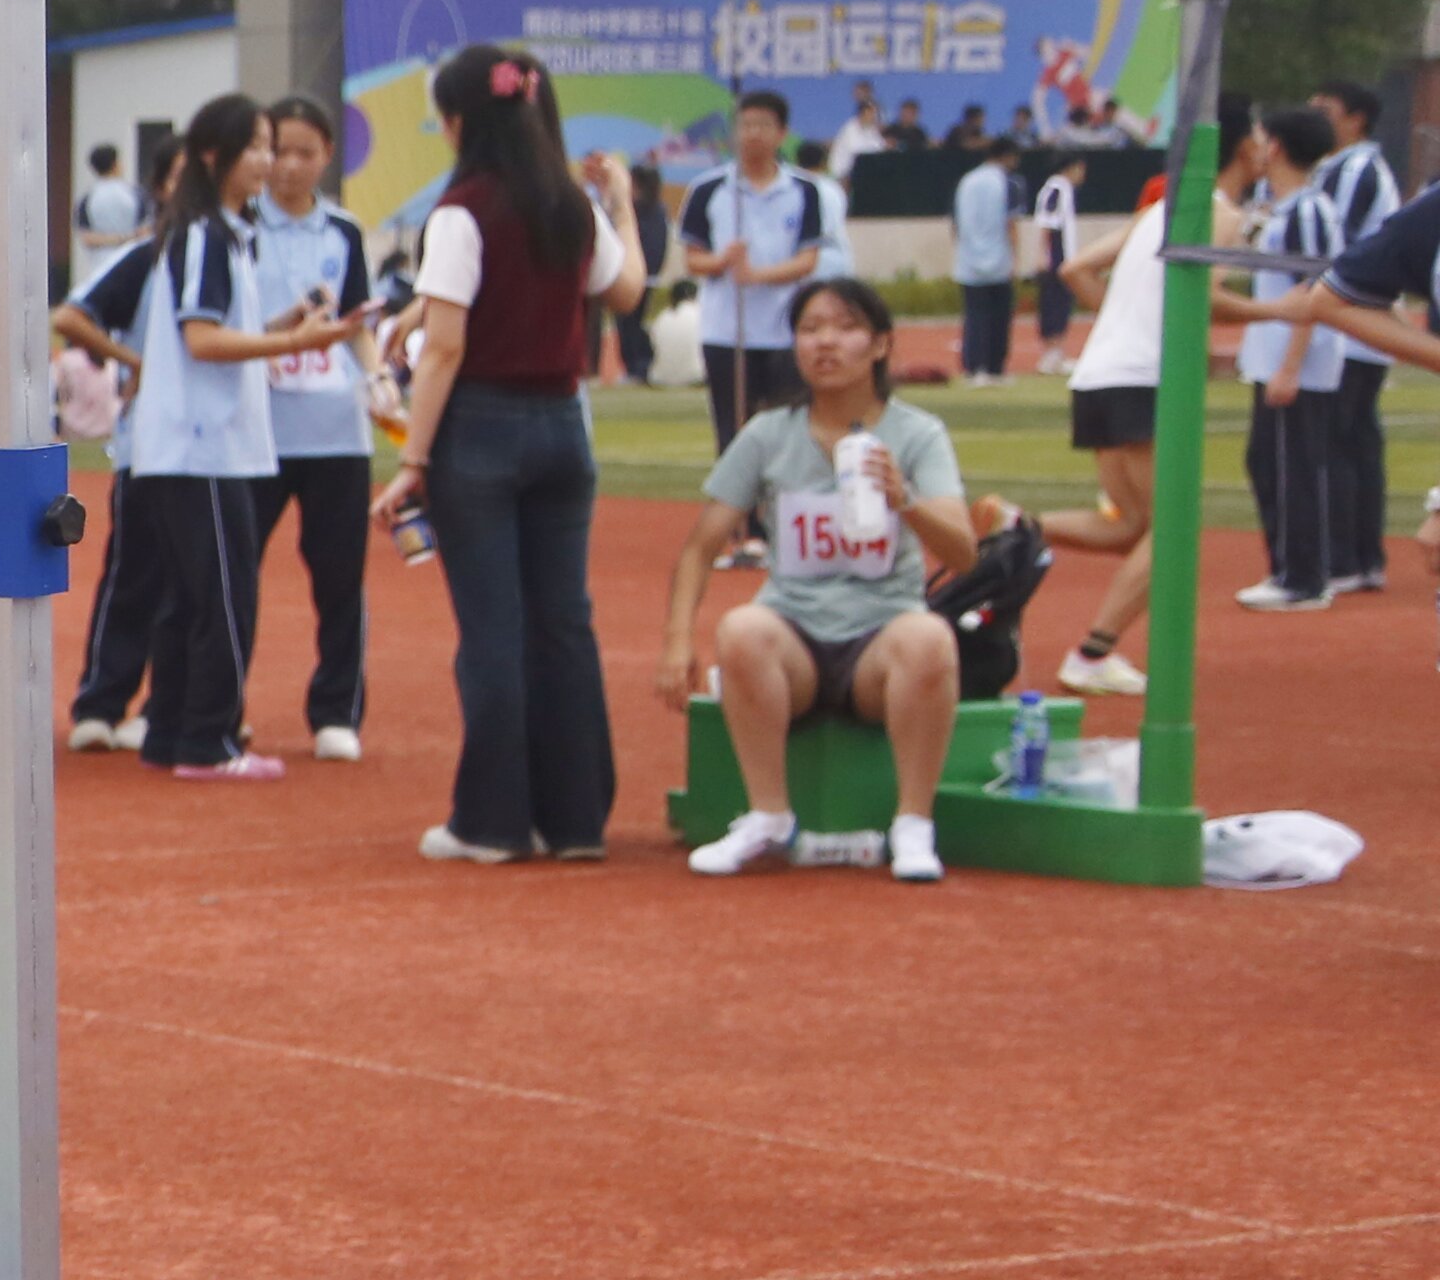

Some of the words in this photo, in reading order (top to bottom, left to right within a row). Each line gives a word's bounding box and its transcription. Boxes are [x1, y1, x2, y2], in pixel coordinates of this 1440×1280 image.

[711, 0, 1006, 76] 校园运动会
